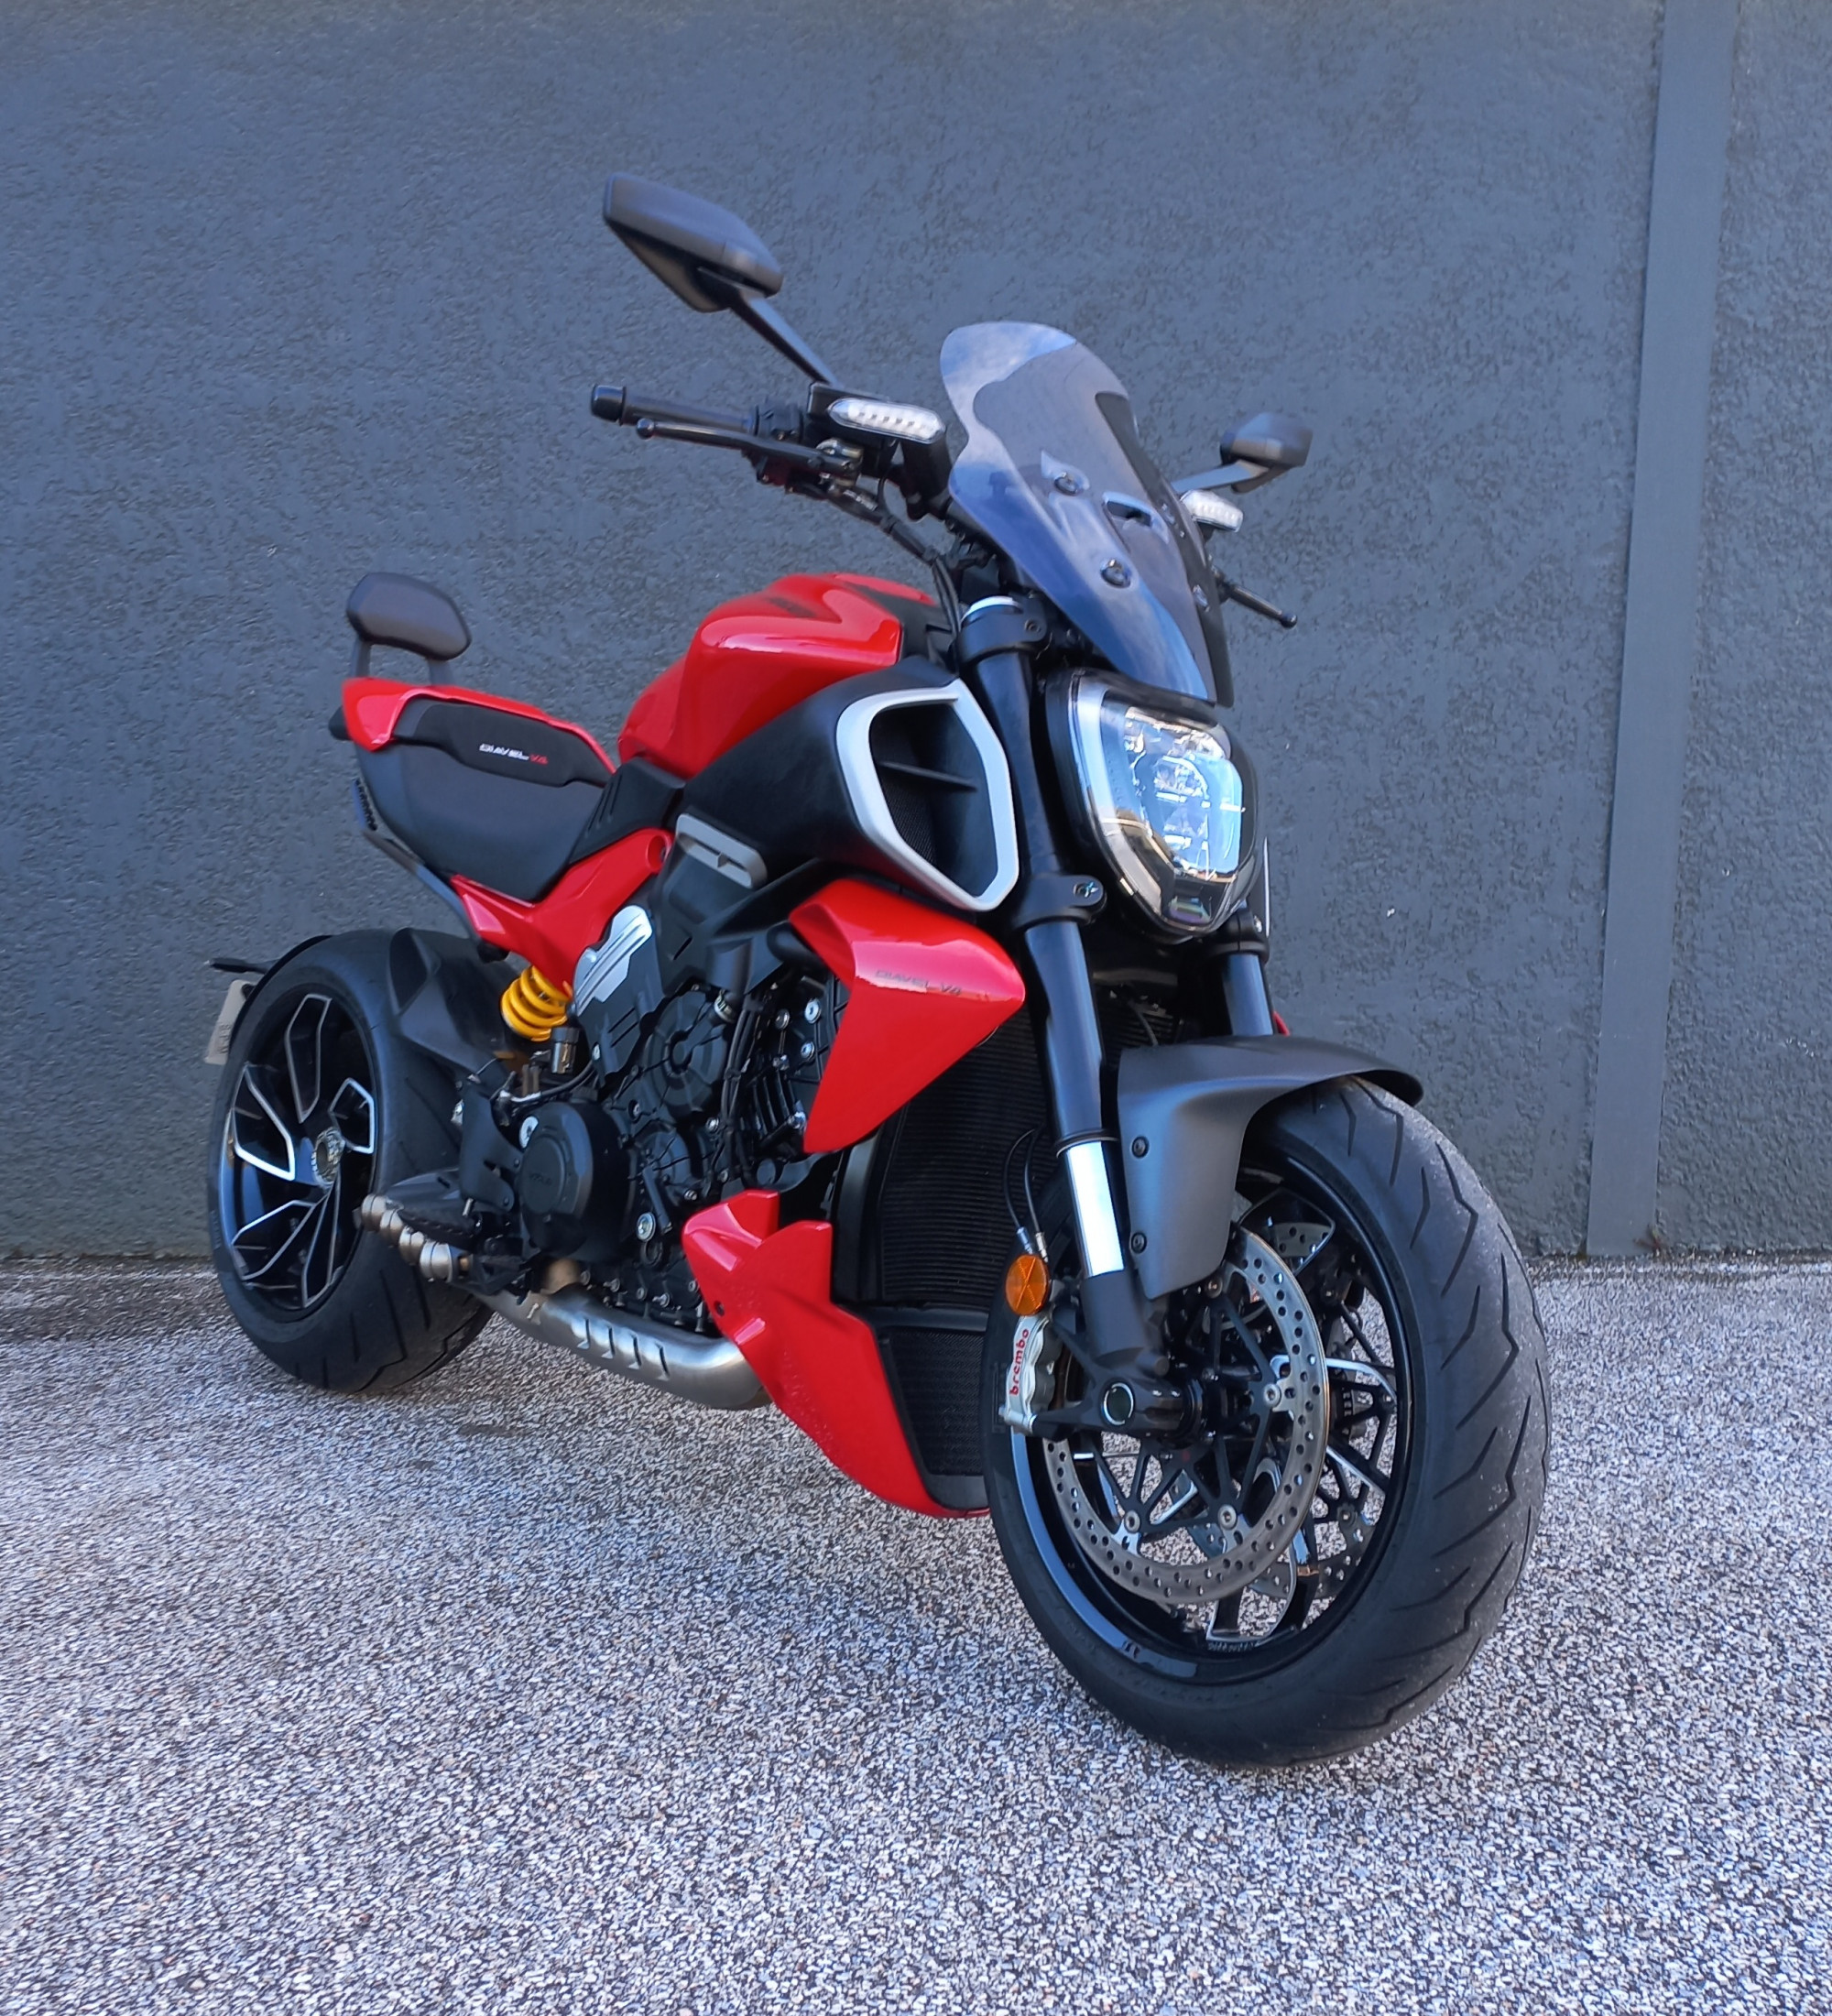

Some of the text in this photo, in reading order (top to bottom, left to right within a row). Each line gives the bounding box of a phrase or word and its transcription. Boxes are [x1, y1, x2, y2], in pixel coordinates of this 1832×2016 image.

[875, 969, 961, 997] DIAVEL V4
[1009, 1328, 1029, 1396] brembo
